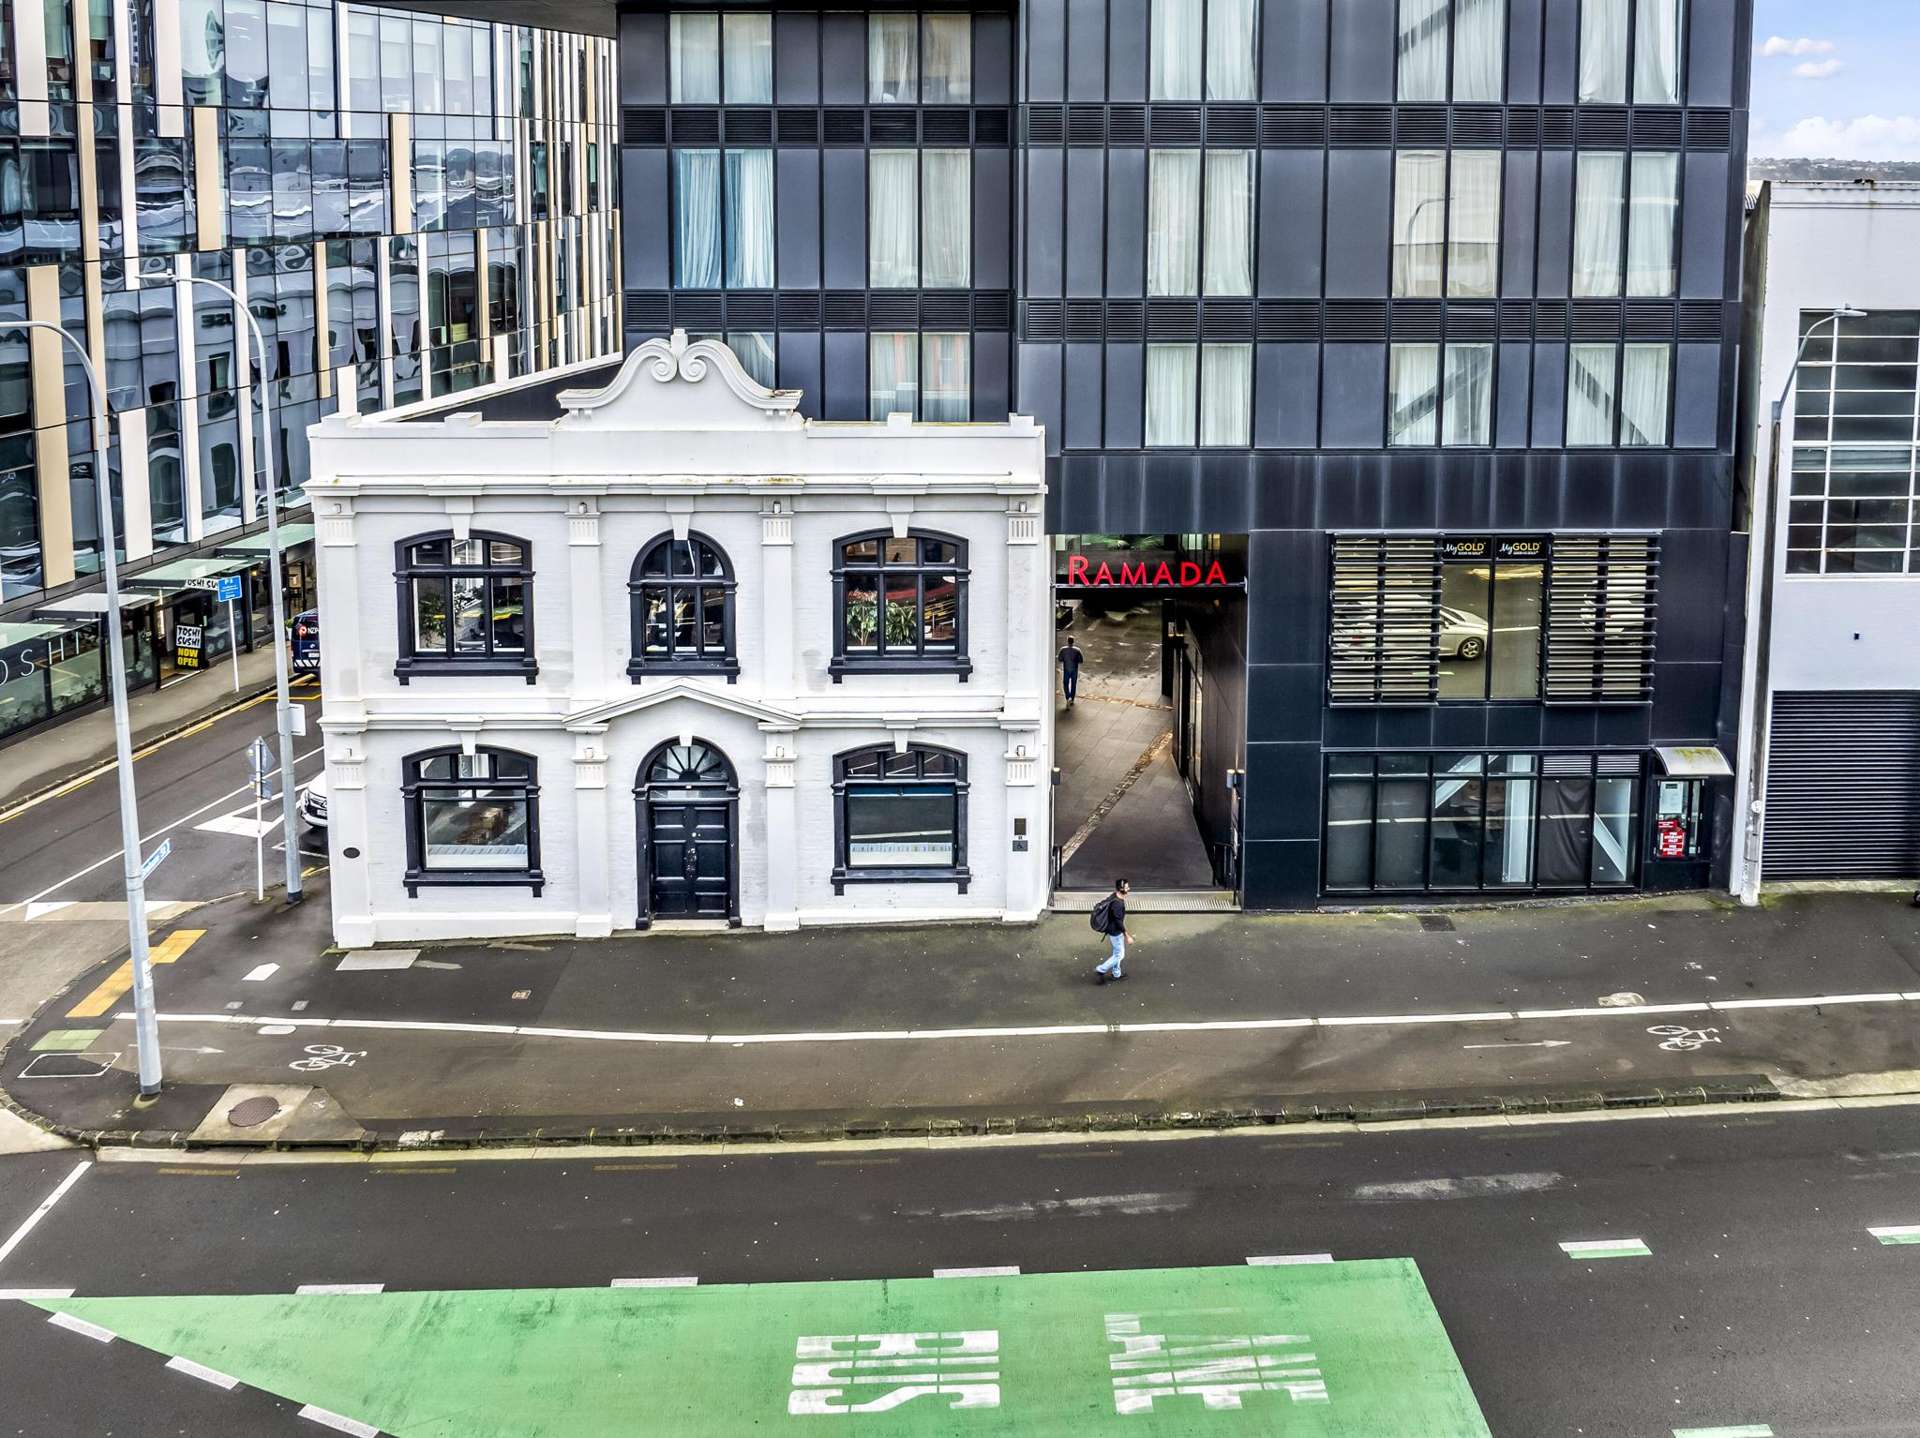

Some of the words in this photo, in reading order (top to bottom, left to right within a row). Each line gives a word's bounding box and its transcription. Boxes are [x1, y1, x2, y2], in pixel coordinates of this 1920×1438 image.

[1068, 555, 1227, 587] RAMADA
[178, 627, 201, 637] TOSHI
[178, 637, 200, 647] SUSHI
[178, 648, 198, 657] NOW
[178, 657, 198, 667] OPEN
[1104, 1309, 1330, 1414] LANE
[788, 1330, 1000, 1415] BUS
